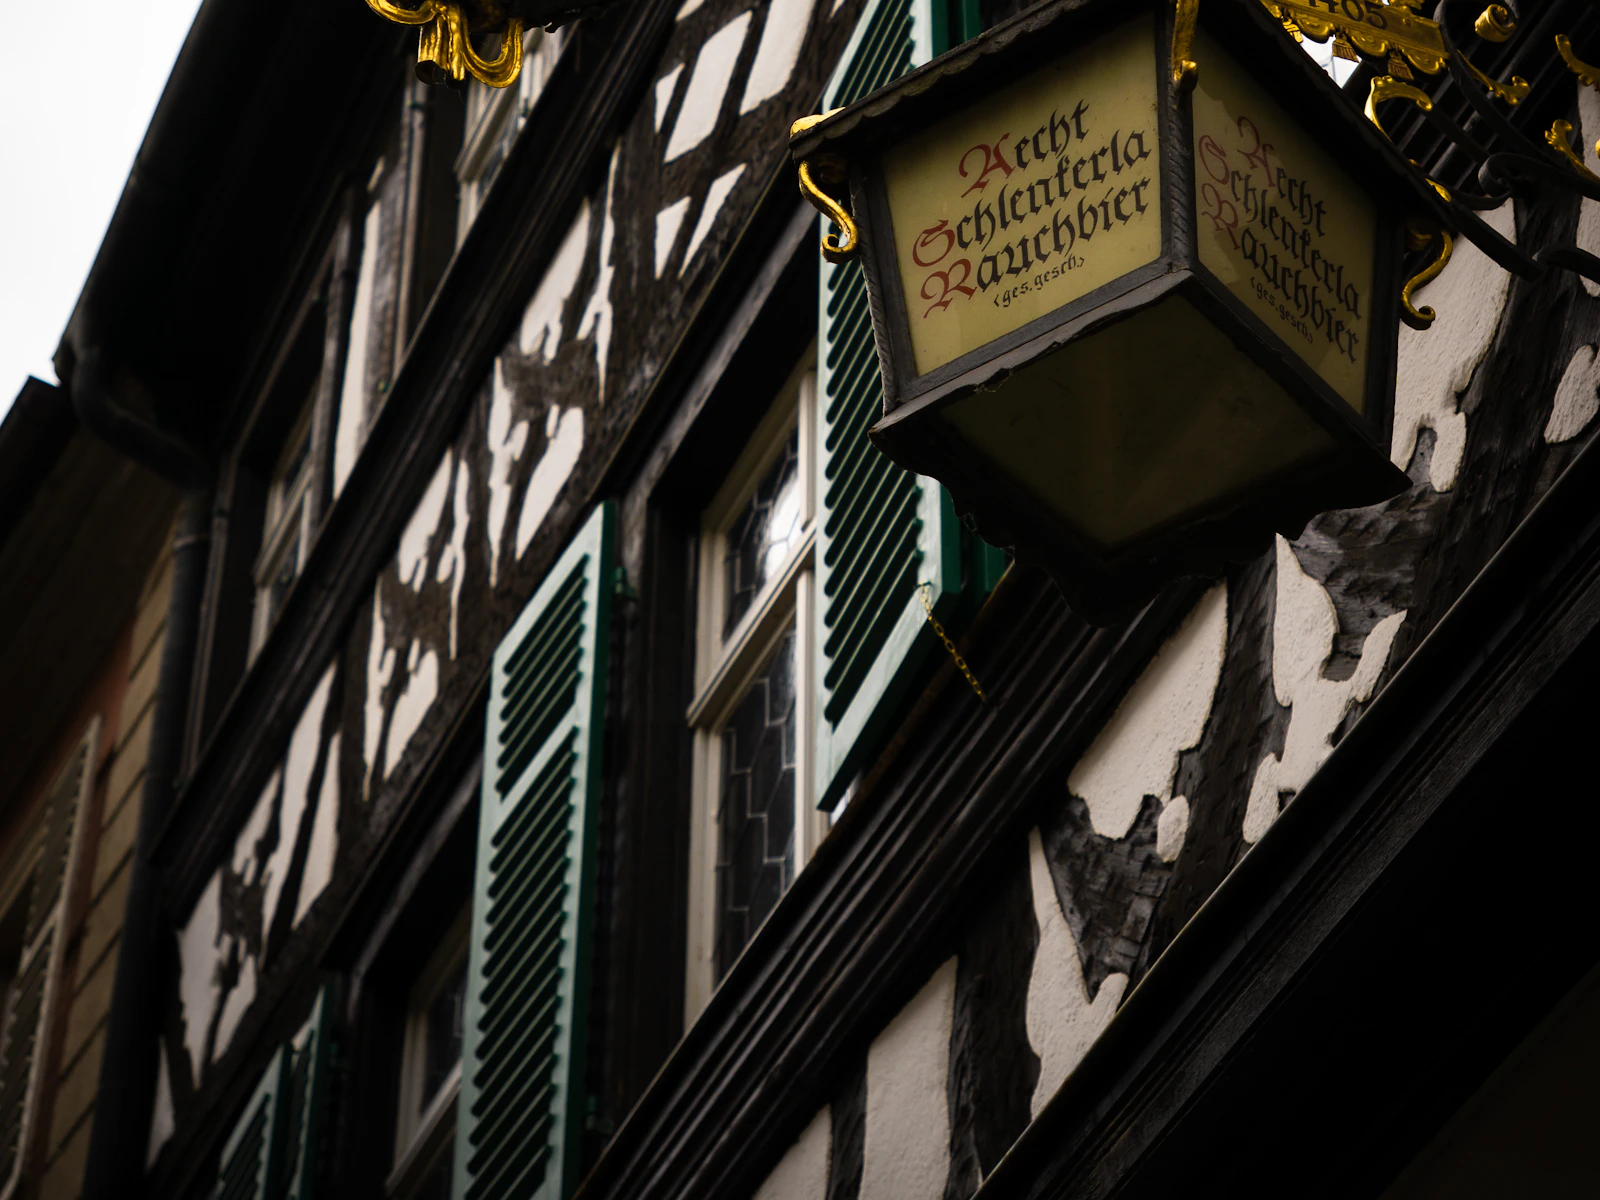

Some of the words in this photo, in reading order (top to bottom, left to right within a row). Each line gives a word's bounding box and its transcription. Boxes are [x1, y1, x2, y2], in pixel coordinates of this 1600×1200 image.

[912, 129, 1152, 268] Schlenkerla
[958, 99, 1090, 198] Aecht
[1236, 115, 1326, 237] Aecht
[920, 178, 1151, 319] Rauchbier
[1198, 134, 1362, 320] Schlenkerla
[1201, 182, 1359, 364] Rauchbier
